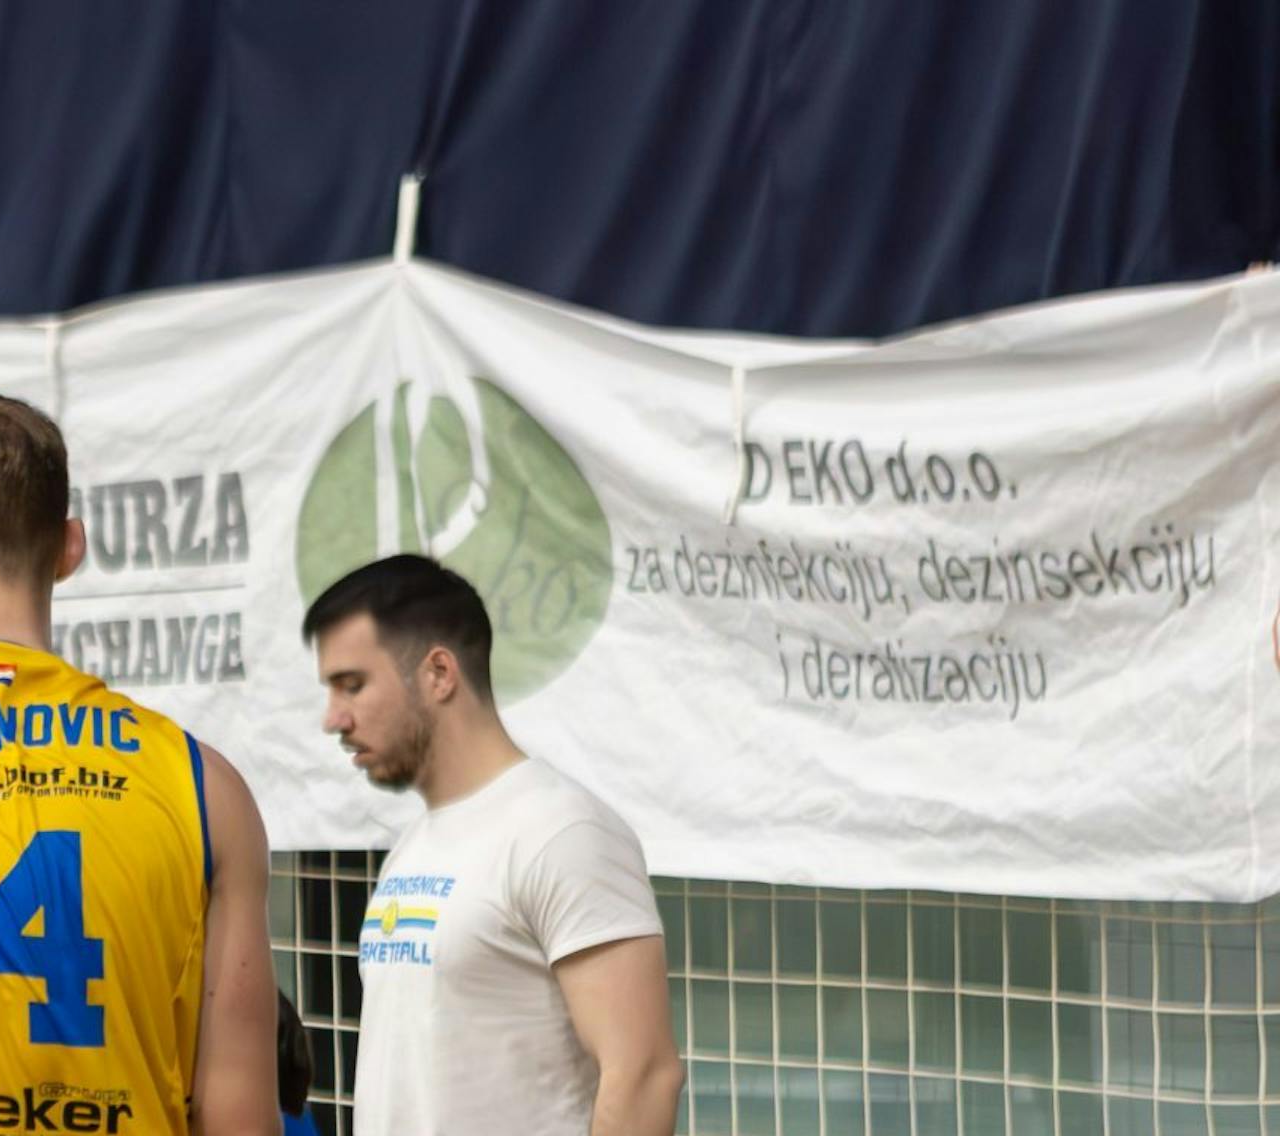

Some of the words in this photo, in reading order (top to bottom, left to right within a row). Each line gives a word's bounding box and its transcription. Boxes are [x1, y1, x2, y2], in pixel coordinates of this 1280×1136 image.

[783, 438, 874, 506] EKO
[885, 440, 1018, 504] d.o.o.
[626, 547, 667, 593] za
[918, 530, 1217, 610] dezinsekciju
[52, 612, 248, 691] CHANGE
[776, 632, 790, 698] i
[801, 634, 1047, 721] deratizaciju
